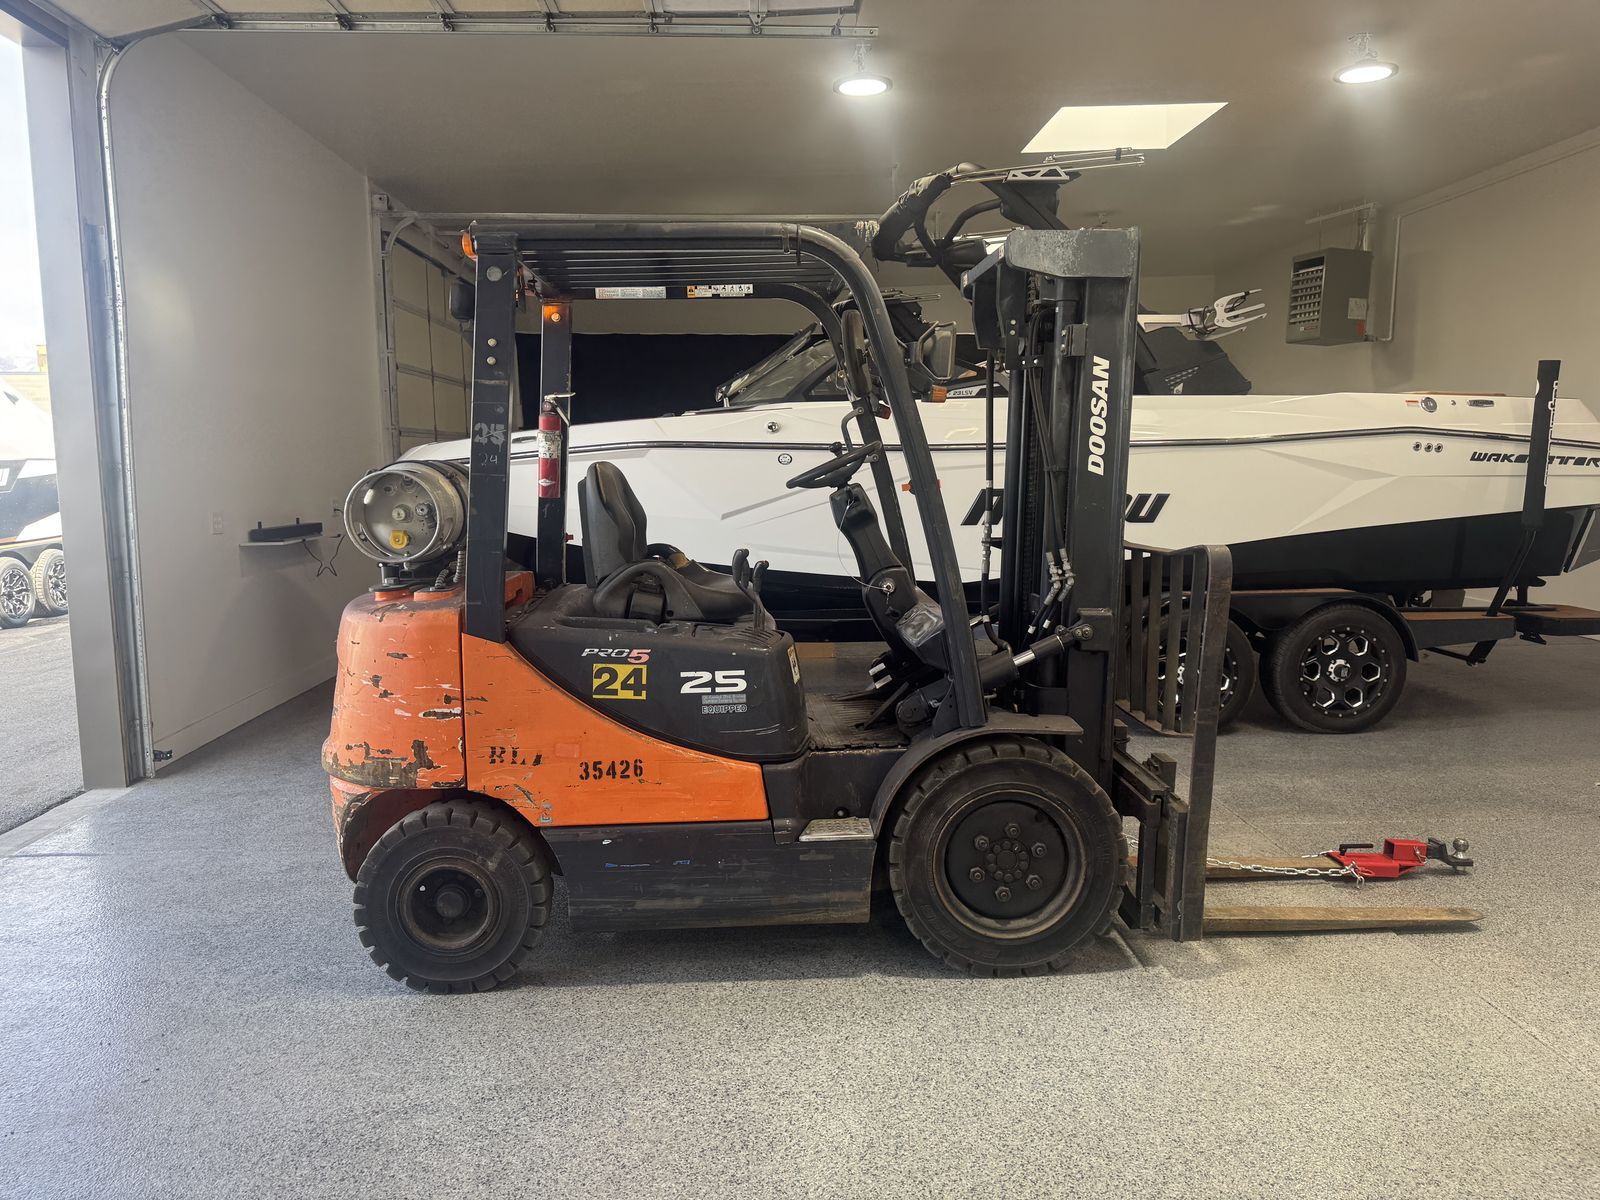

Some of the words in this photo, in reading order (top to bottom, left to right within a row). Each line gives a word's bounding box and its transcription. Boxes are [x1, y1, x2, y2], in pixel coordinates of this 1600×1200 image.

[1088, 355, 1110, 476] DOOSAN
[1470, 451, 1600, 468] WAKETTER
[581, 648, 652, 664] PRO5
[593, 666, 647, 697] 24
[680, 670, 747, 693] 25
[702, 704, 748, 714] EQUIPPED
[579, 759, 643, 780] 35426
